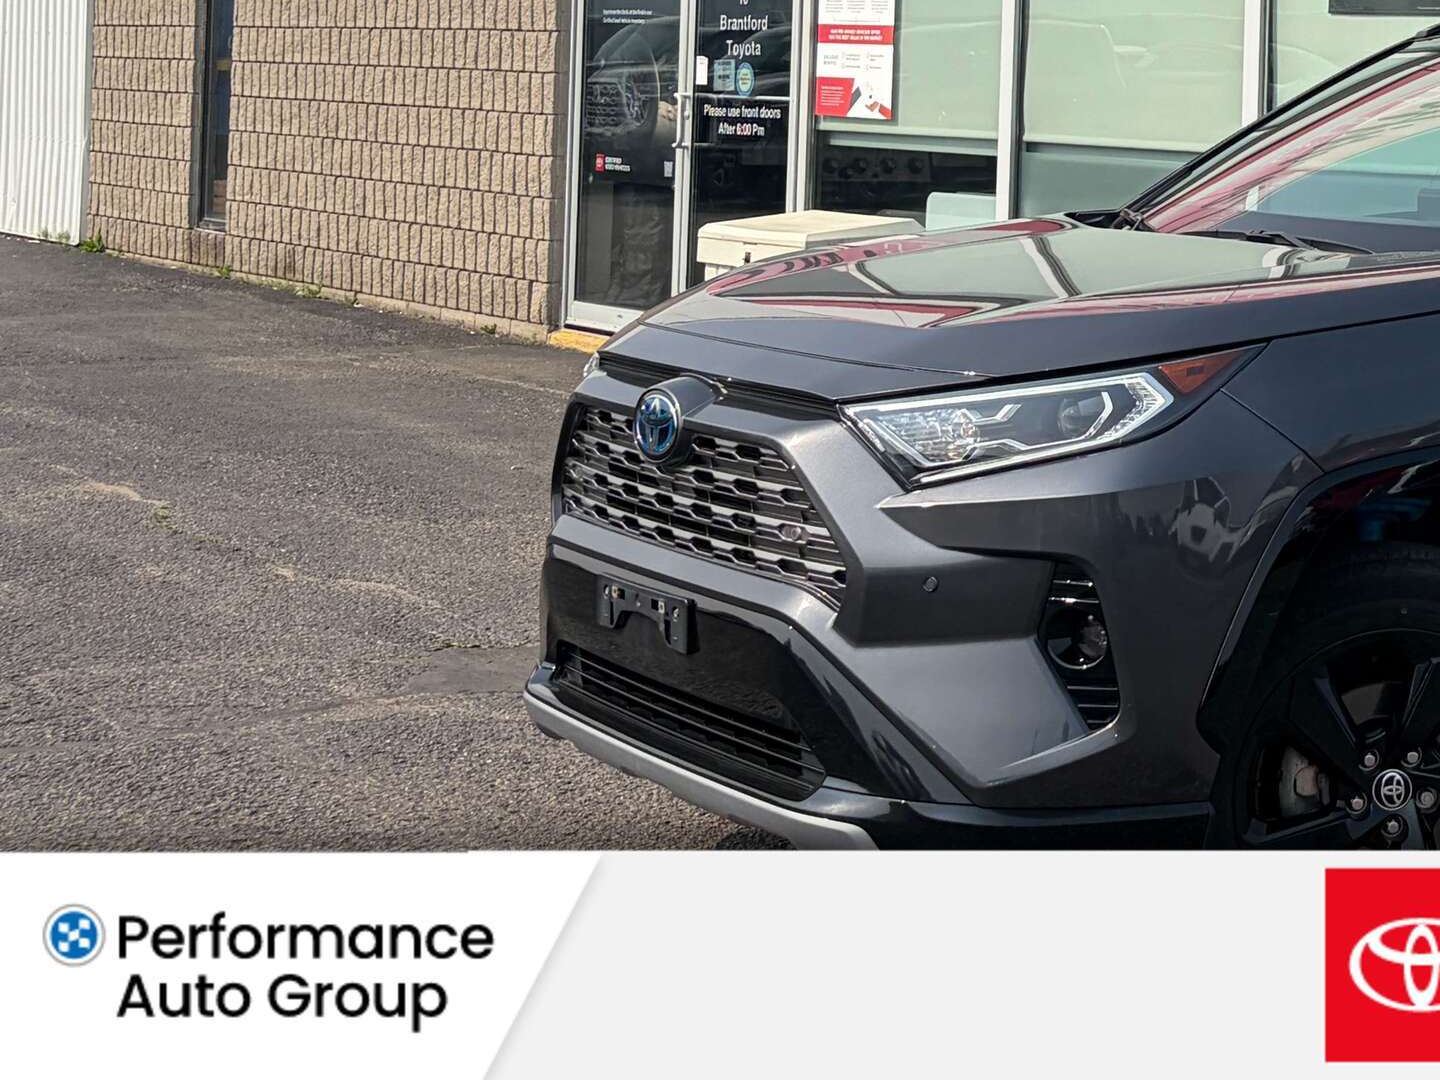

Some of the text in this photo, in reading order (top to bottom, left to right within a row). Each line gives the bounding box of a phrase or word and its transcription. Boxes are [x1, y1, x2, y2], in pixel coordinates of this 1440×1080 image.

[720, 14, 769, 31] Brantford
[726, 39, 761, 60] Toyota
[704, 104, 781, 119] Please use front doors
[718, 122, 736, 135] After
[736, 123, 752, 135] 6:00
